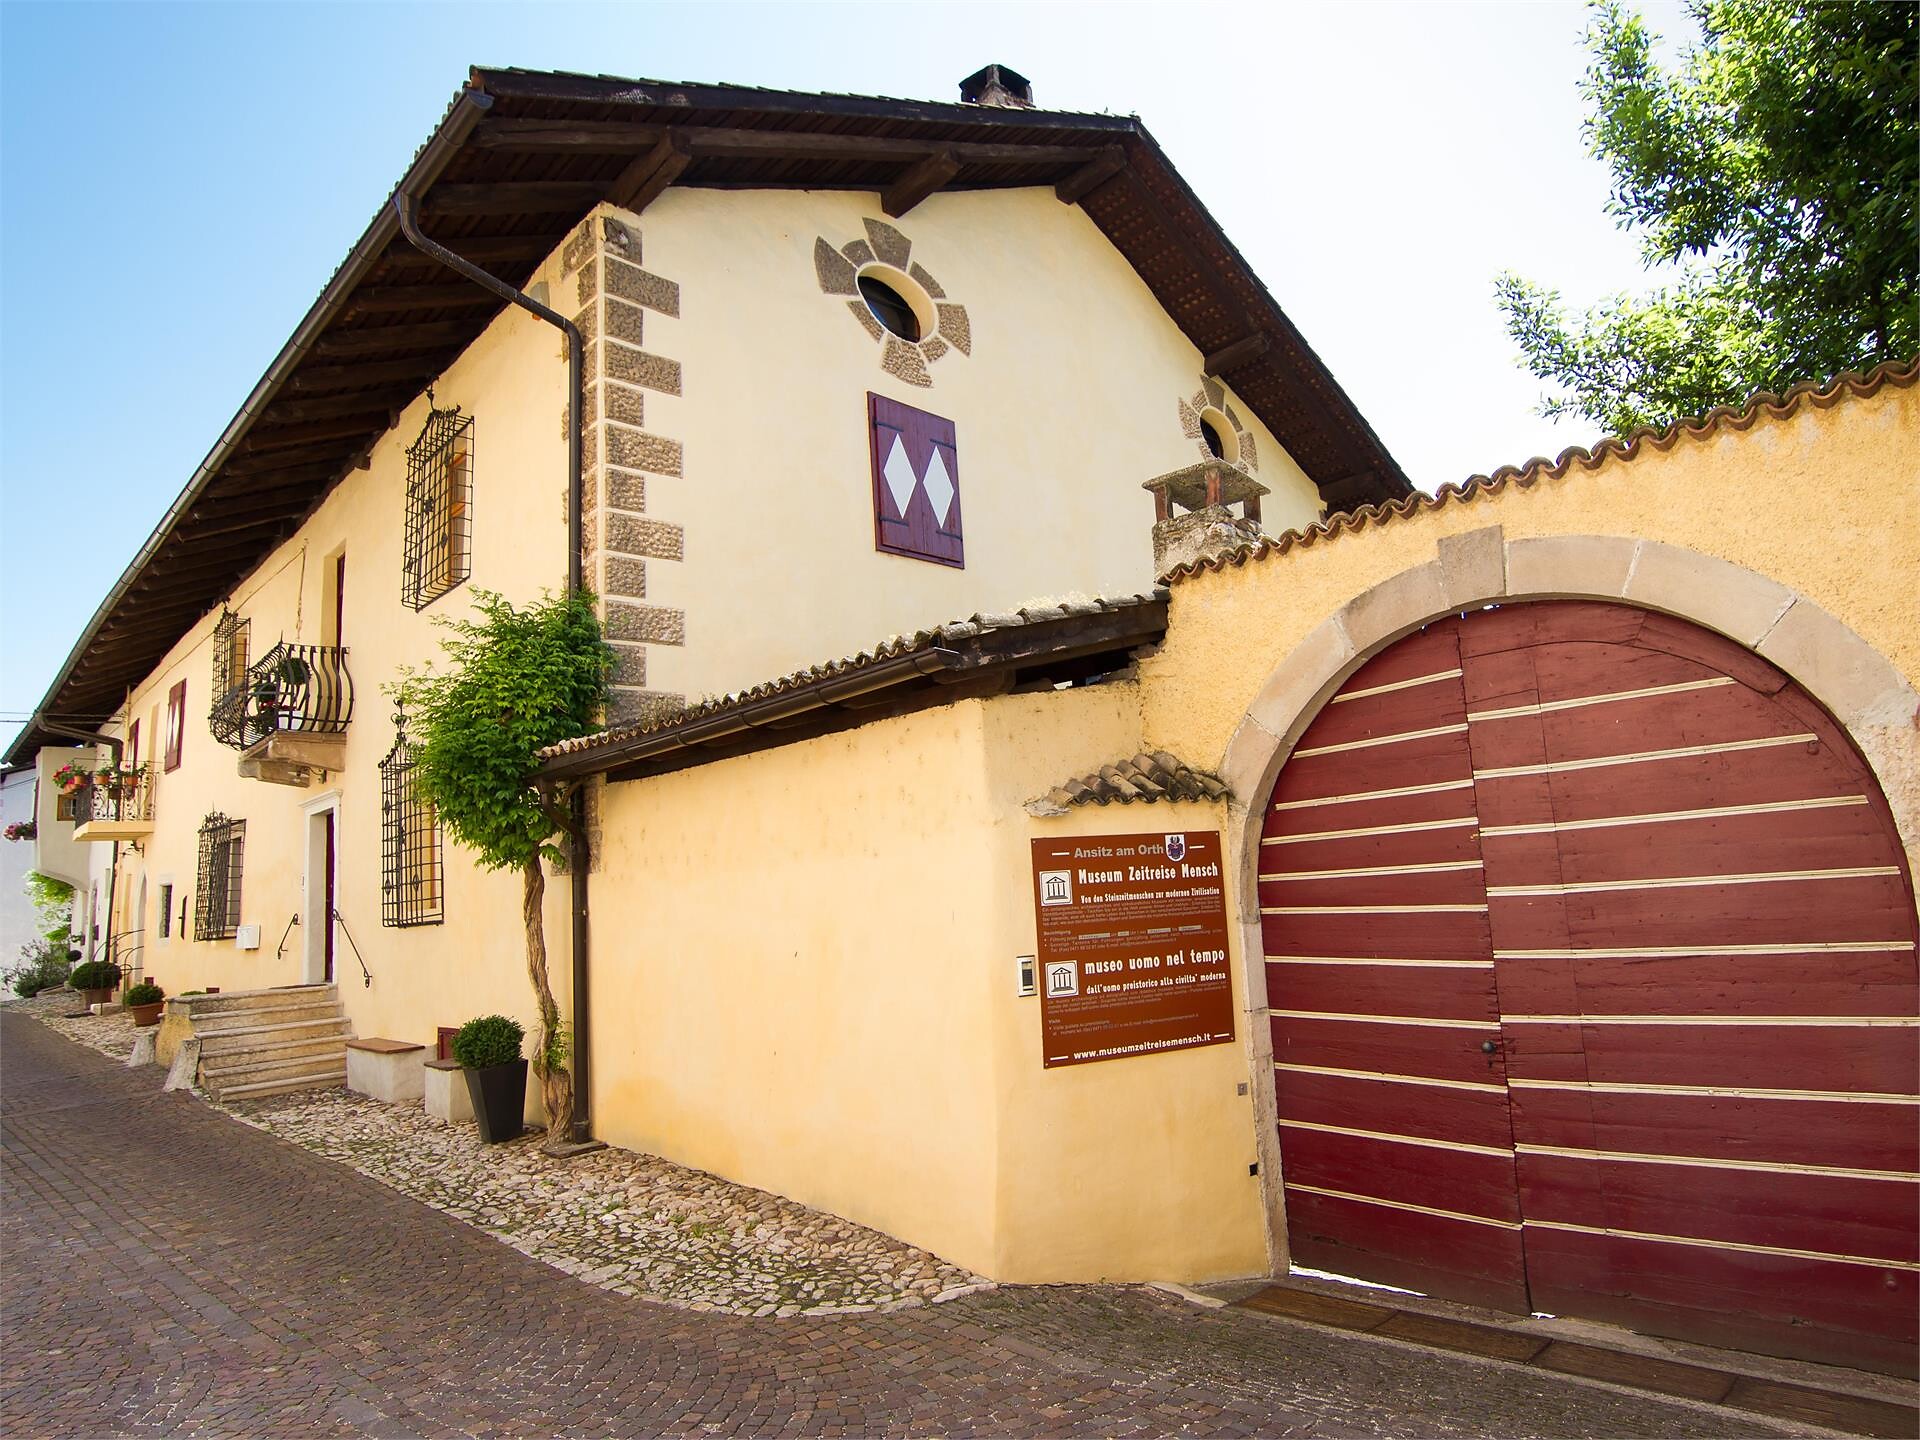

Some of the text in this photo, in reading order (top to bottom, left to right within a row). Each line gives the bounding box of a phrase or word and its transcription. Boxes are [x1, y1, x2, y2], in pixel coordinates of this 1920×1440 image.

[1074, 844, 1164, 858] Ansitz am Orth
[1078, 862, 1218, 884] Museum Zeitreise Mensch
[1080, 886, 1220, 904] Von den Steinzeitmenschen zur modernen Zivilisation
[1084, 949, 1225, 974] museo uomo nel tempo
[1086, 983, 1121, 995] dall'uomo
[1122, 978, 1158, 992] preistorico
[1160, 977, 1174, 987] alla
[1200, 971, 1226, 982] moderna
[1073, 1033, 1211, 1060] www.museumzeitreisemensch.it
